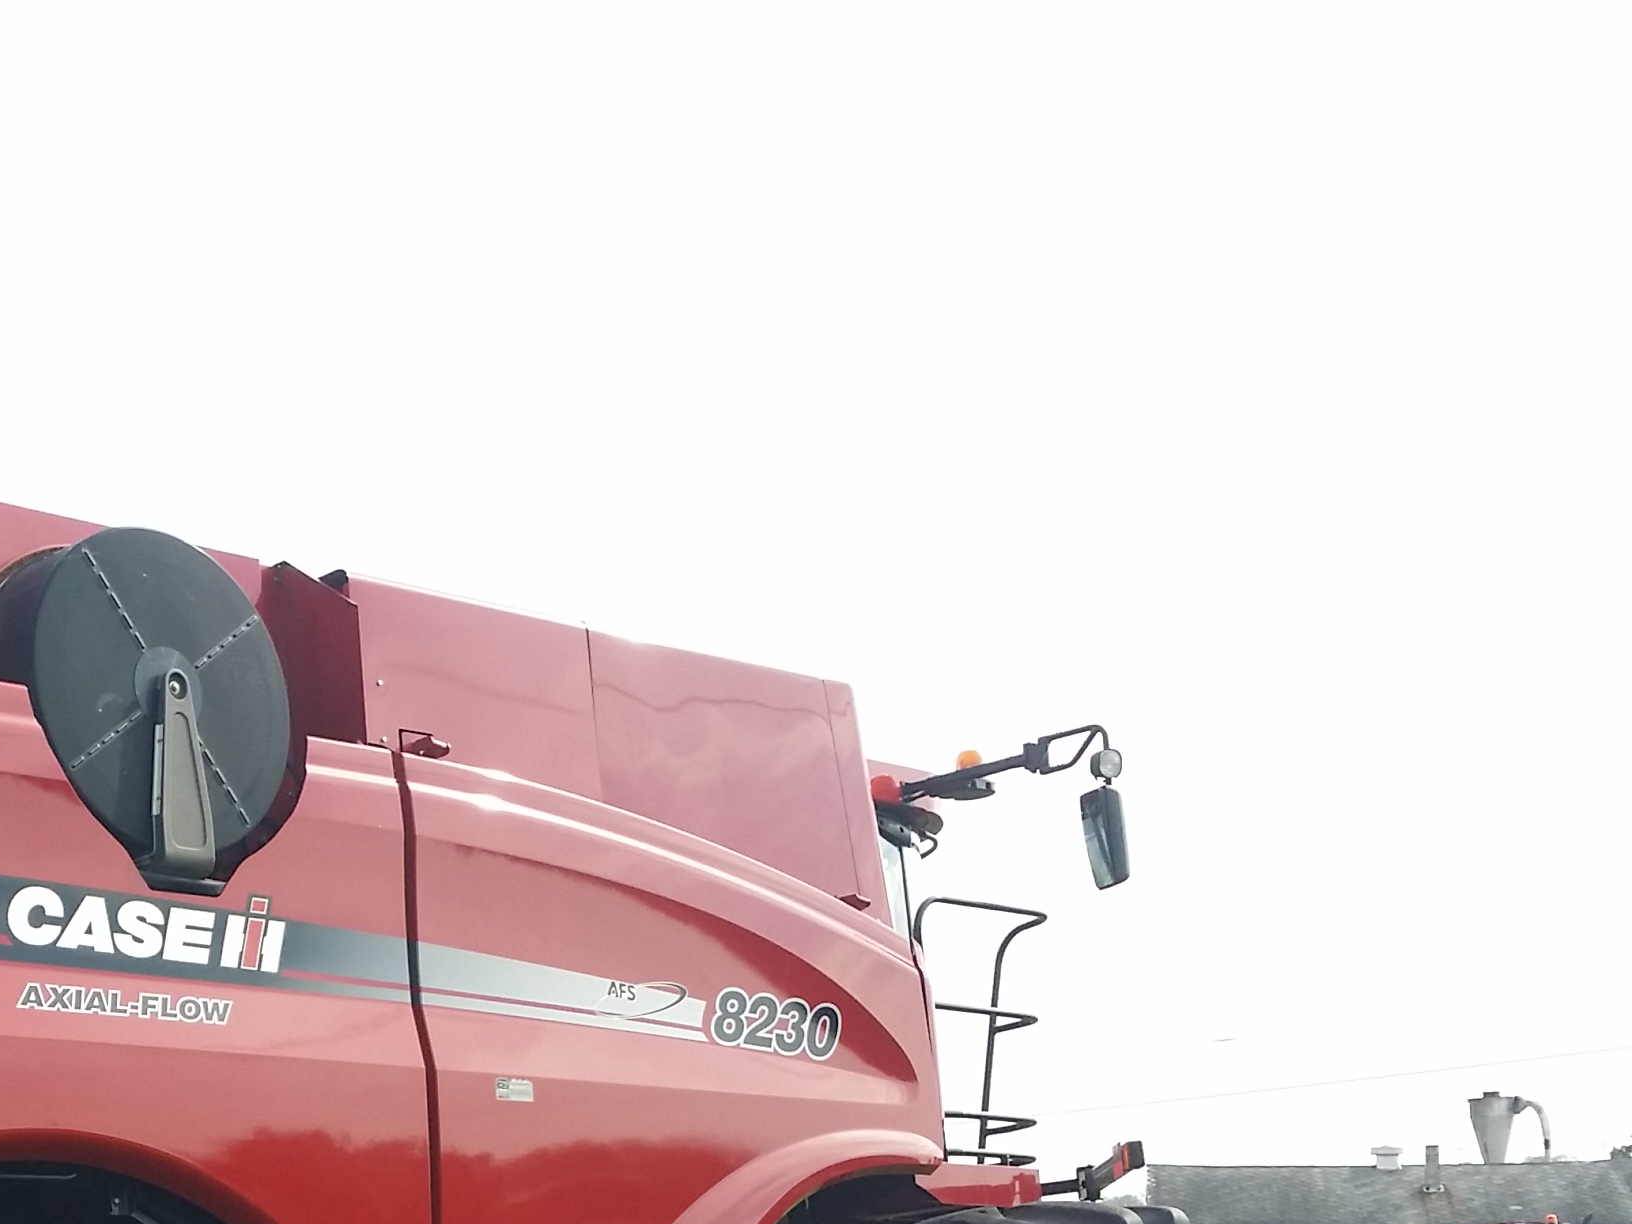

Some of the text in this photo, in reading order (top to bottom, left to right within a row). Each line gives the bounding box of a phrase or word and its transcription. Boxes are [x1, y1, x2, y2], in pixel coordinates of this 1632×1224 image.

[7, 885, 216, 965] CASE
[16, 982, 233, 1026] AXIAL-FLOW
[608, 981, 636, 1001] AFS
[710, 986, 842, 1061] 8230
